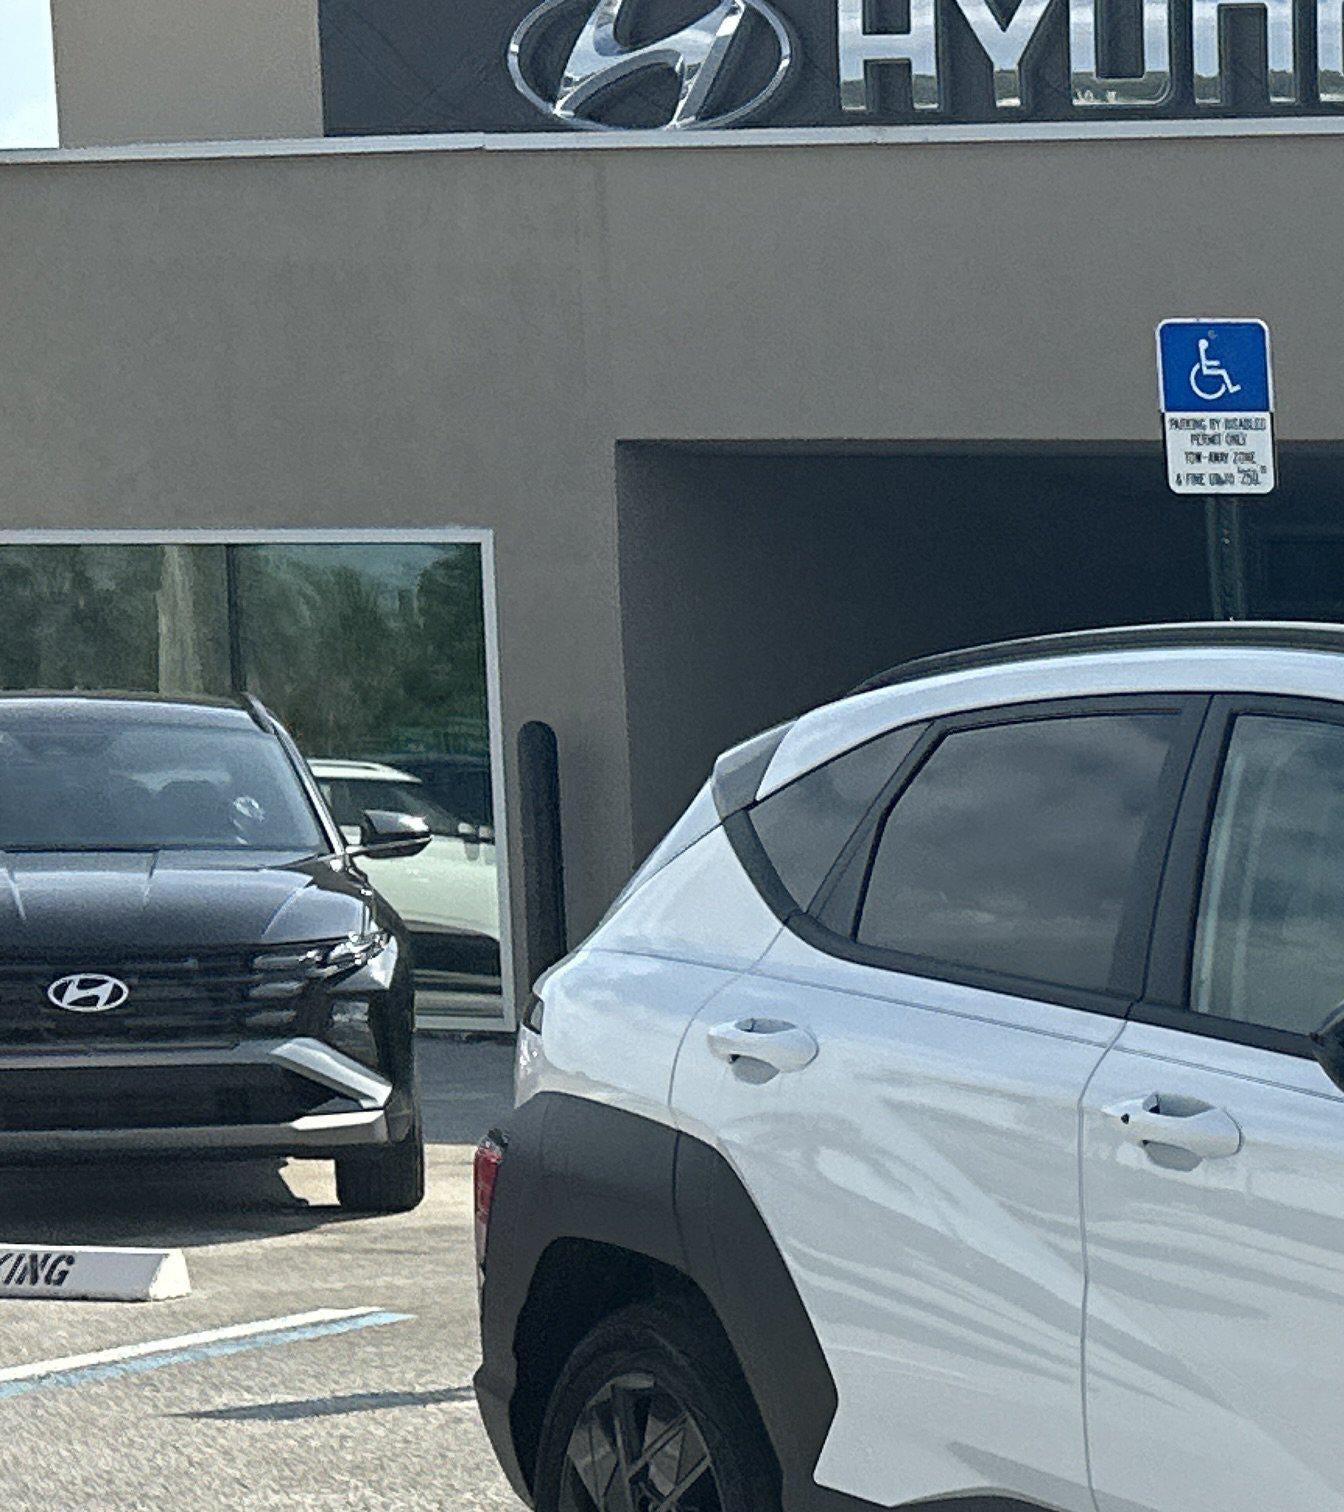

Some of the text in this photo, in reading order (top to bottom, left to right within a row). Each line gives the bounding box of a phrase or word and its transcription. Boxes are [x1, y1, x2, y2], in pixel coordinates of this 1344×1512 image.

[1169, 417, 1266, 431] PARKING BY DISABLED
[1232, 451, 1257, 464] ZONE
[0, 1252, 75, 1286] ING
